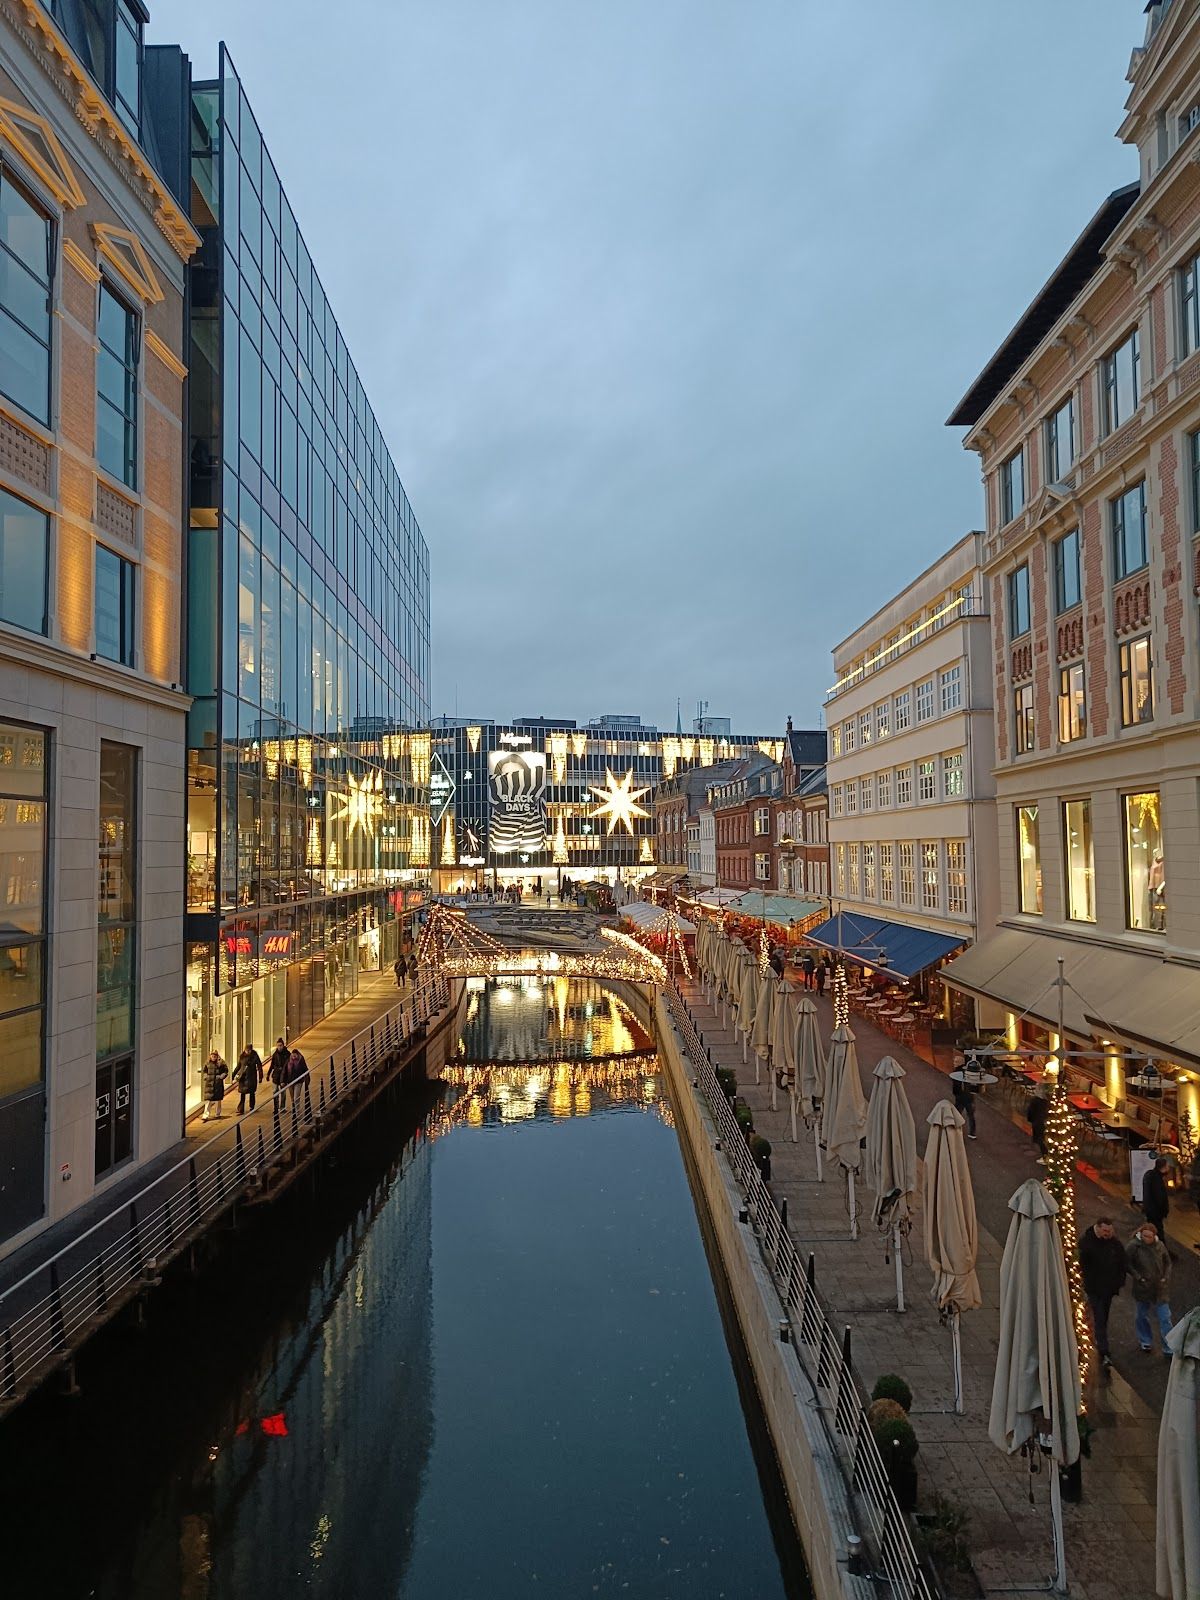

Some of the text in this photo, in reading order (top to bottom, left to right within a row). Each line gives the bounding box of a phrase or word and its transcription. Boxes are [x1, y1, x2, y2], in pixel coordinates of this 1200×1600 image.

[502, 795, 534, 803] BLACK
[505, 803, 531, 812] DAYS
[264, 936, 289, 953] H&M
